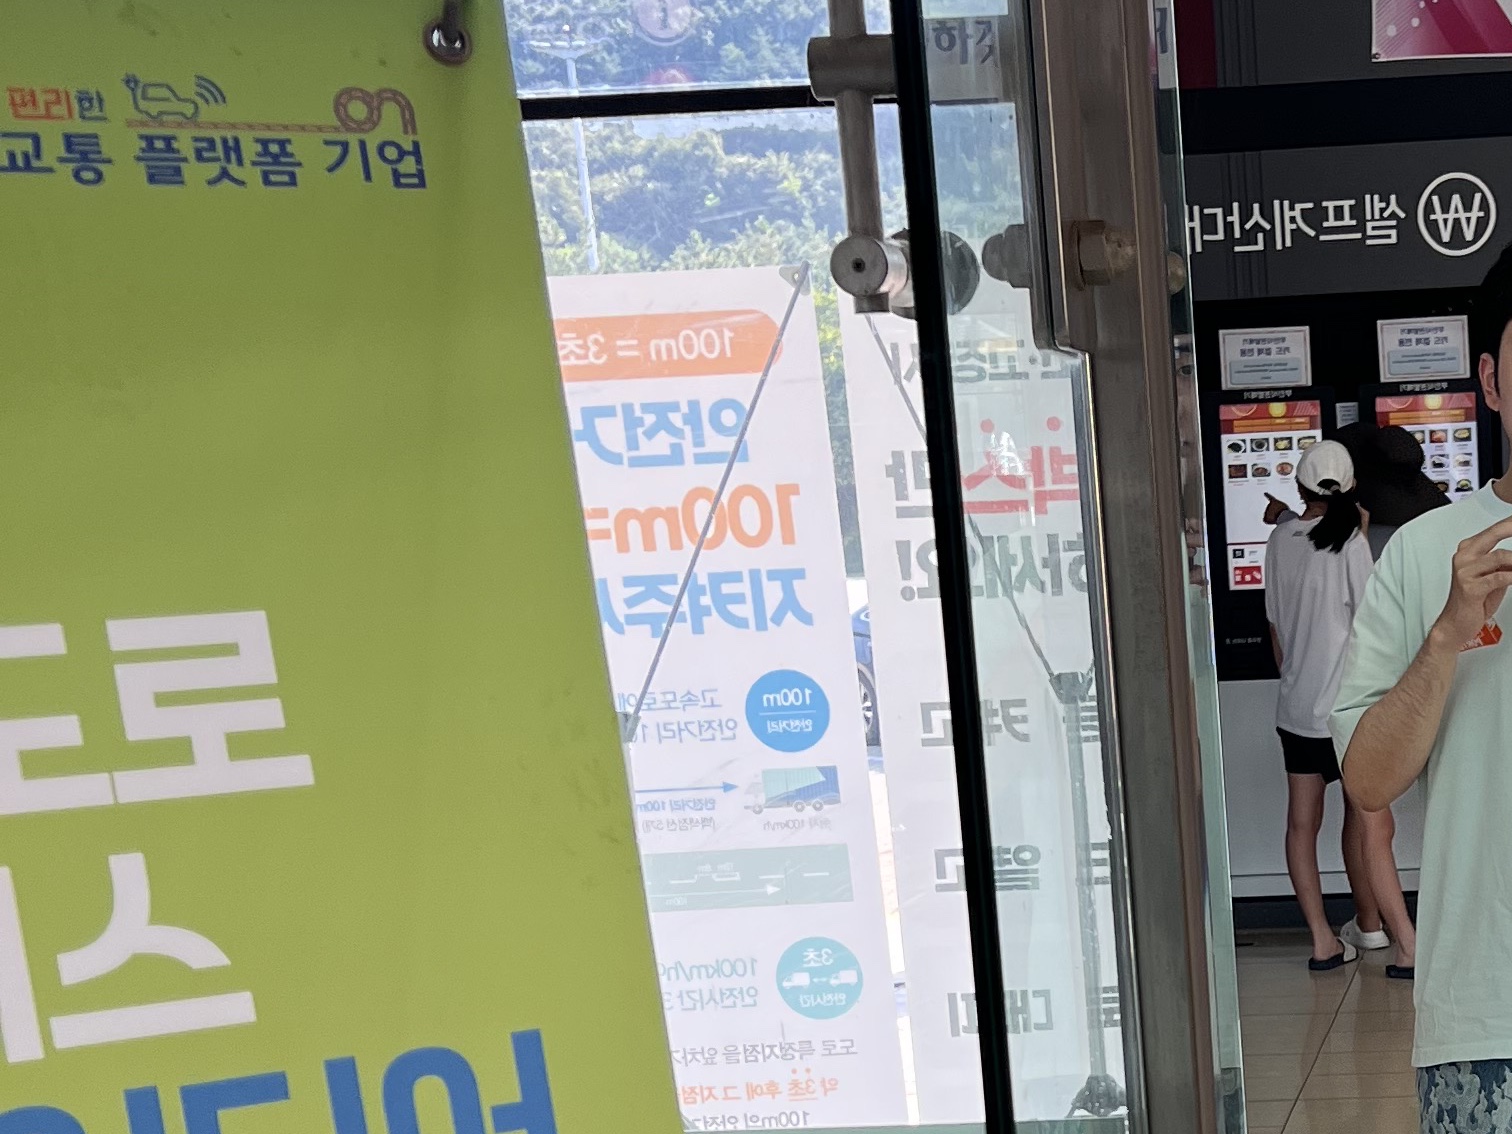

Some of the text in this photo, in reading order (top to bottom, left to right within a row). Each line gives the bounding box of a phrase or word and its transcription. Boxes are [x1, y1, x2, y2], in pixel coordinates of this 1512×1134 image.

[6, 86, 108, 122] 편리한
[0, 131, 428, 190] 교통 플랫폼 기업
[0, 852, 257, 1063] 스
